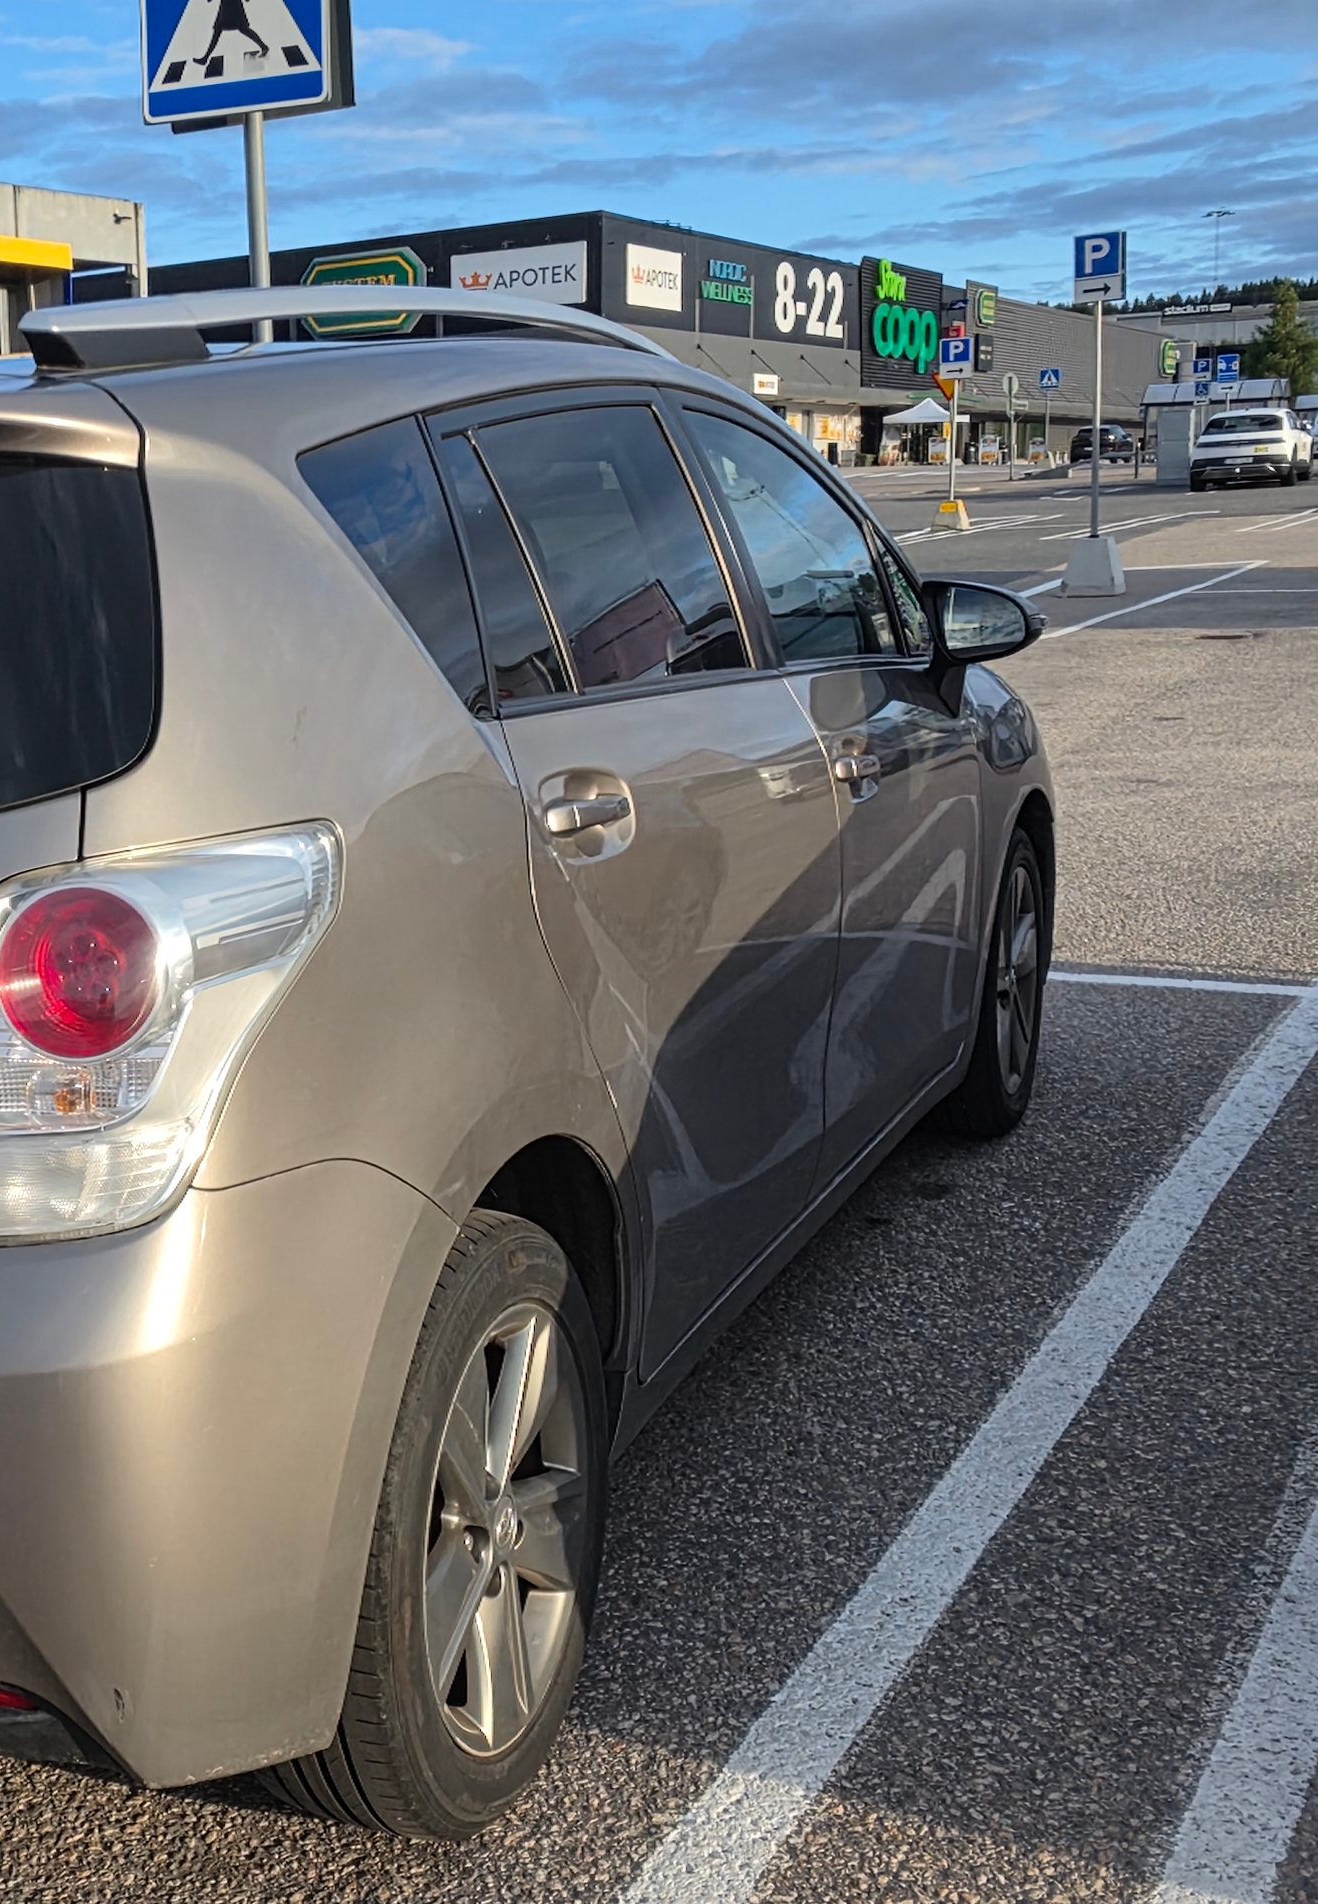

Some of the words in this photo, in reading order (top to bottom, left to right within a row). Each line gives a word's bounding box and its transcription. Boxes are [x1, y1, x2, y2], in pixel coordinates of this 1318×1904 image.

[1084, 238, 1110, 274] P
[493, 263, 577, 289] APOTEK
[645, 268, 679, 291] APOTEK
[709, 259, 747, 282] NORDIC
[701, 280, 753, 305] WELLNESS
[774, 261, 844, 338] 8-22
[1164, 303, 1209, 316] stadium
[873, 303, 938, 375] coop
[949, 341, 964, 361] P
[1198, 361, 1207, 372] P
